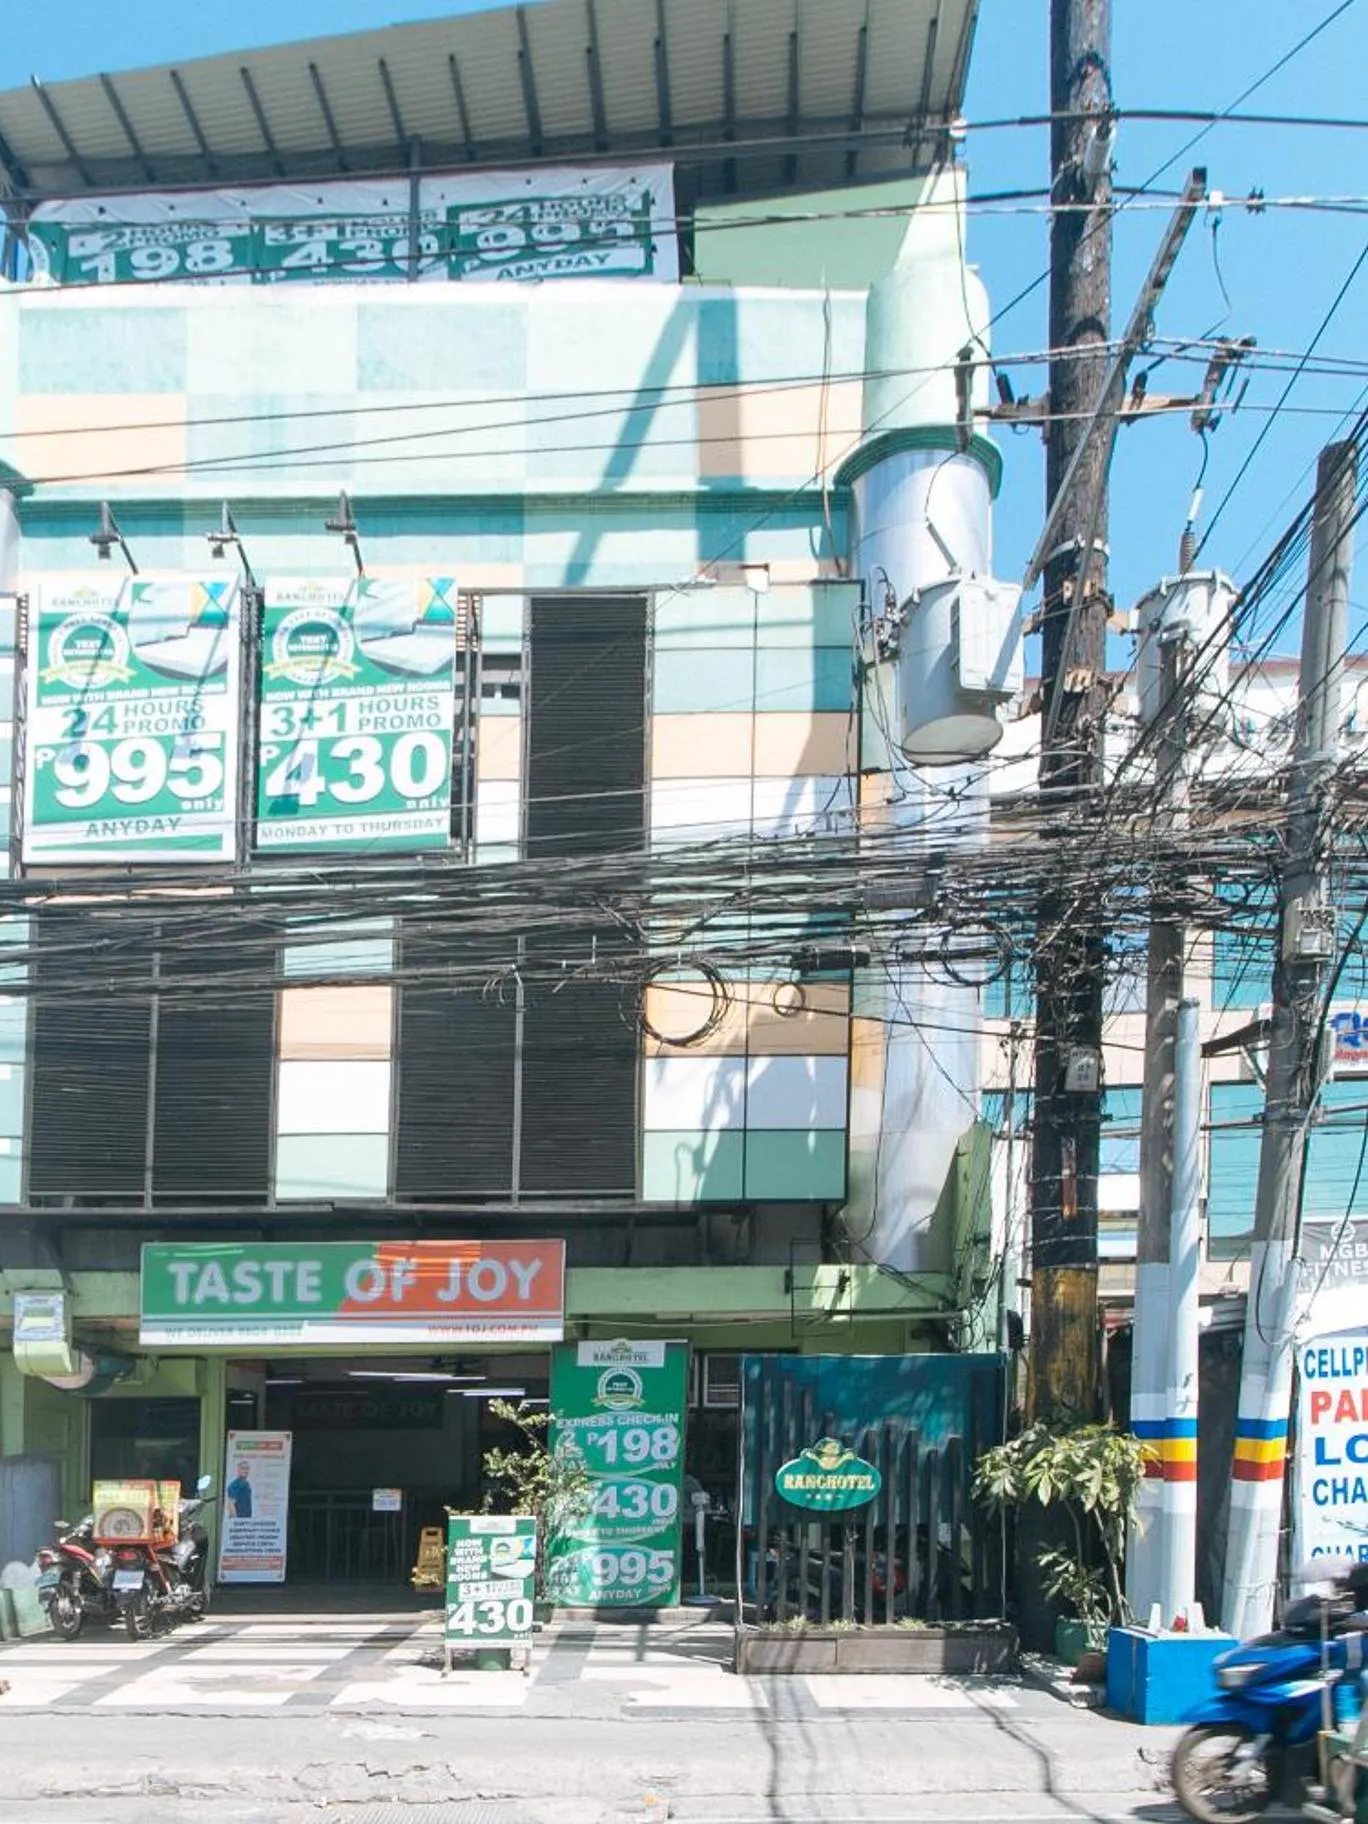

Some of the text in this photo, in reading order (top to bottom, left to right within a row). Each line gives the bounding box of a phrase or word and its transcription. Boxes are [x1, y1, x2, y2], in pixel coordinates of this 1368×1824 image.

[476, 221, 635, 262] 995
[80, 238, 234, 283] 198
[497, 252, 612, 281] ANYDAY
[60, 698, 204, 739] 24 HOURS
[123, 714, 206, 734] PROMO
[270, 695, 440, 737] 3+1 HOURS
[358, 712, 442, 732] PROMO
[54, 733, 224, 809] 995
[265, 730, 447, 806] 430
[85, 816, 182, 838] ANYDAY
[261, 817, 445, 841] MONDAY TO THURSDAY
[168, 1257, 543, 1305] TASTE OF JOY
[1303, 1347, 1368, 1379] CELLP
[556, 1415, 614, 1429] EXPRESS
[1310, 1388, 1368, 1425] PA
[598, 1426, 680, 1465] 198
[592, 1483, 678, 1519] 430
[783, 1474, 875, 1491] RANCHOTEL
[591, 1550, 674, 1587] 995
[588, 1588, 642, 1601] ANYDAY
[448, 1598, 533, 1635] 430
